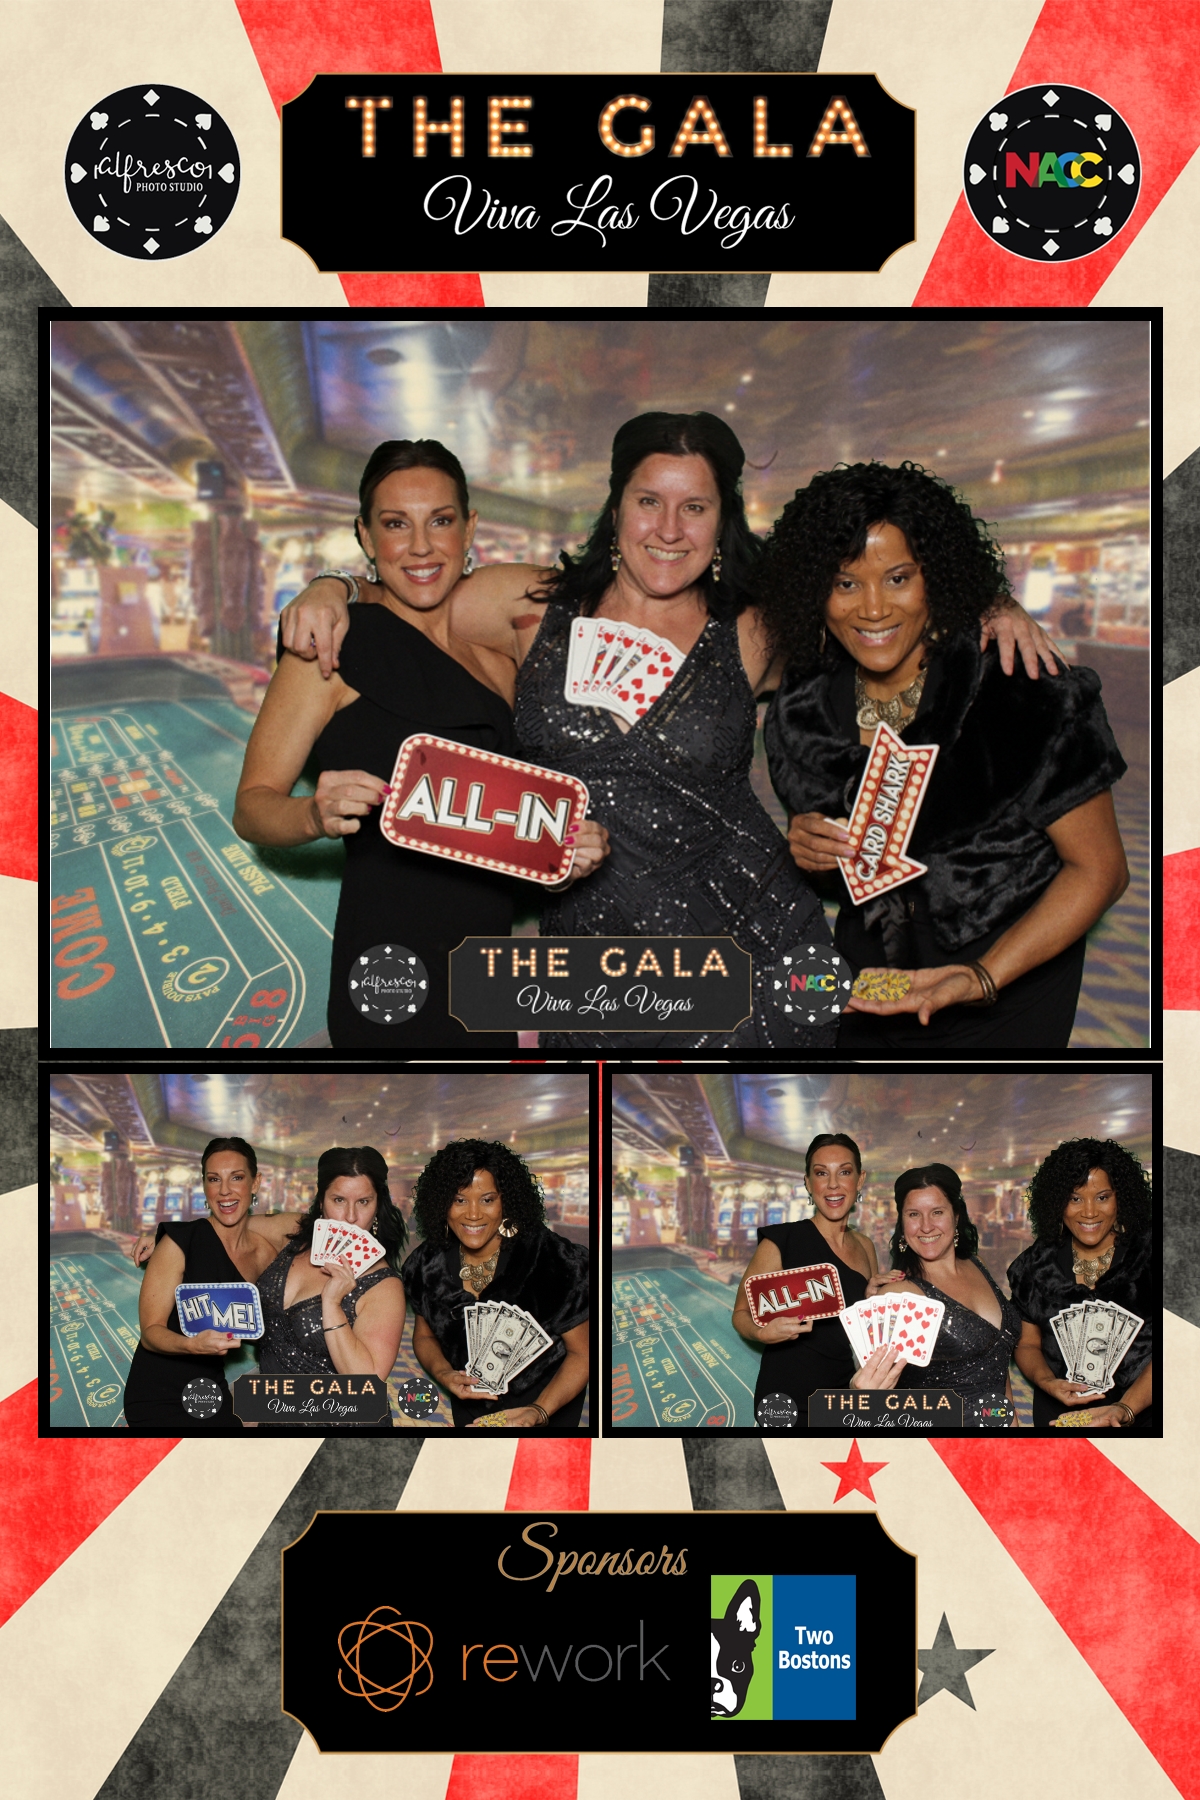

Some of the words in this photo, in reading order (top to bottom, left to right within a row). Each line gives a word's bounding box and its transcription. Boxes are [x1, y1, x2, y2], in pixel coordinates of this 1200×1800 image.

[396, 773, 572, 846] ALL-IN
[855, 823, 888, 882] CARD
[872, 752, 912, 826] SHARK
[221, 843, 252, 868] LINE
[161, 876, 193, 910] FIELD
[238, 865, 275, 896] PASS
[51, 886, 116, 1000] COME
[188, 963, 219, 984] 2
[250, 988, 288, 1009] 8
[181, 1292, 211, 1322] HIT
[211, 1301, 257, 1331] ME!
[758, 1274, 836, 1317] ALL-IN
